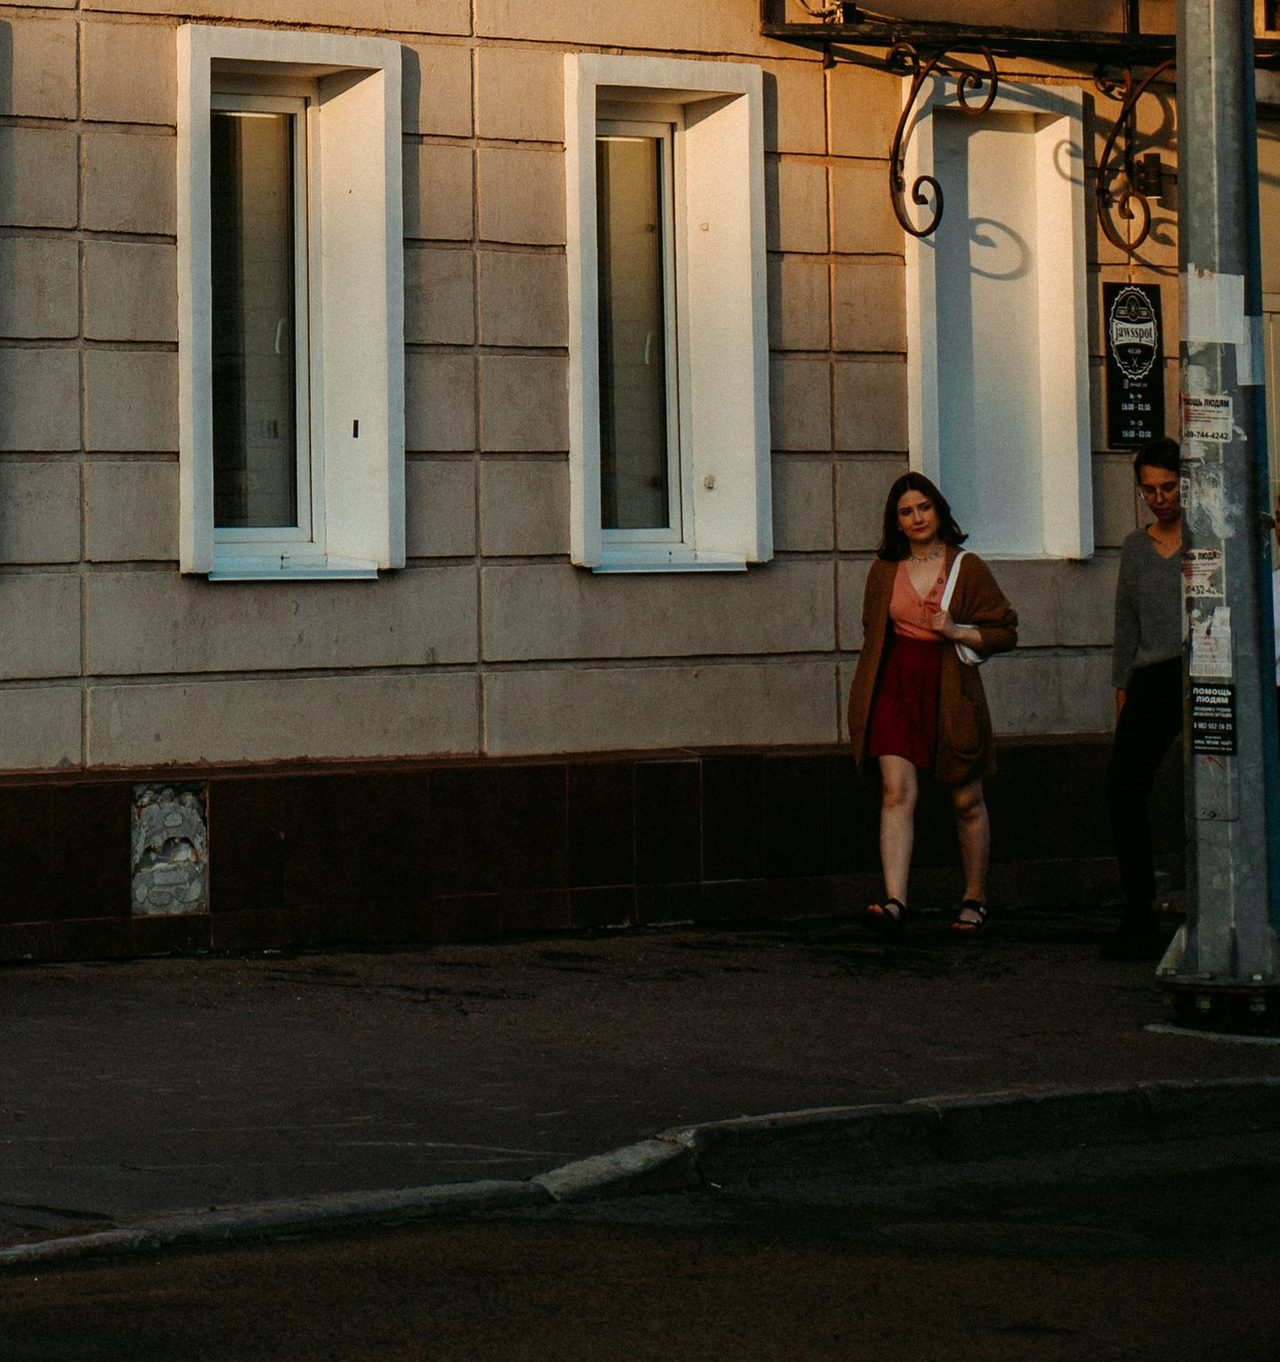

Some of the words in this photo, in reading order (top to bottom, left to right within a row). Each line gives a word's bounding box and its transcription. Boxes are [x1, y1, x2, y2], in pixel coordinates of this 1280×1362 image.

[1115, 323, 1153, 342] jawsspot
[1204, 398, 1229, 408] ЛЮДЯМ
[1193, 687, 1232, 696] ПОМОЩЬ
[1196, 696, 1229, 704] ЛЮДЯМ
